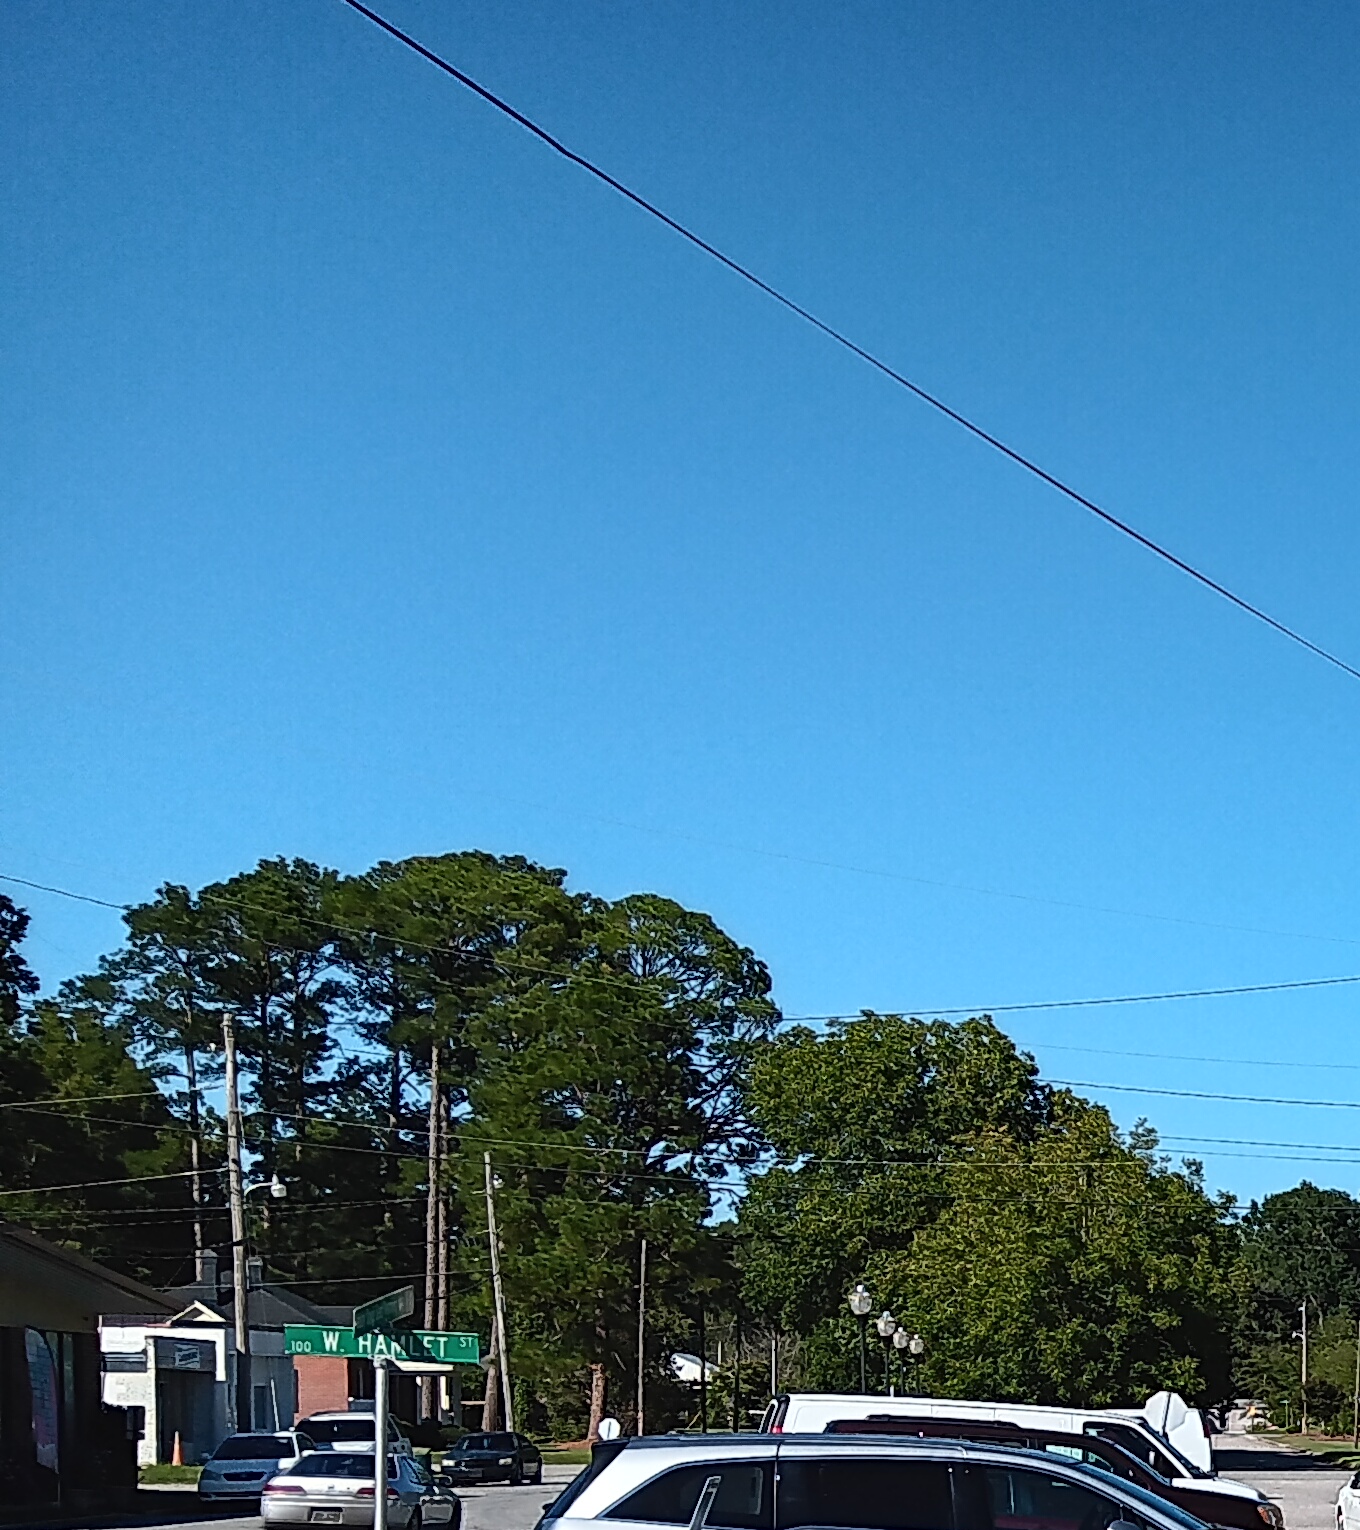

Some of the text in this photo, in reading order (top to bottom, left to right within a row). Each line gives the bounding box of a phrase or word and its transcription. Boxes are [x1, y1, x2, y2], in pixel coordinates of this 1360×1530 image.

[290, 1330, 474, 1359] 100 W. HAMLET ST
